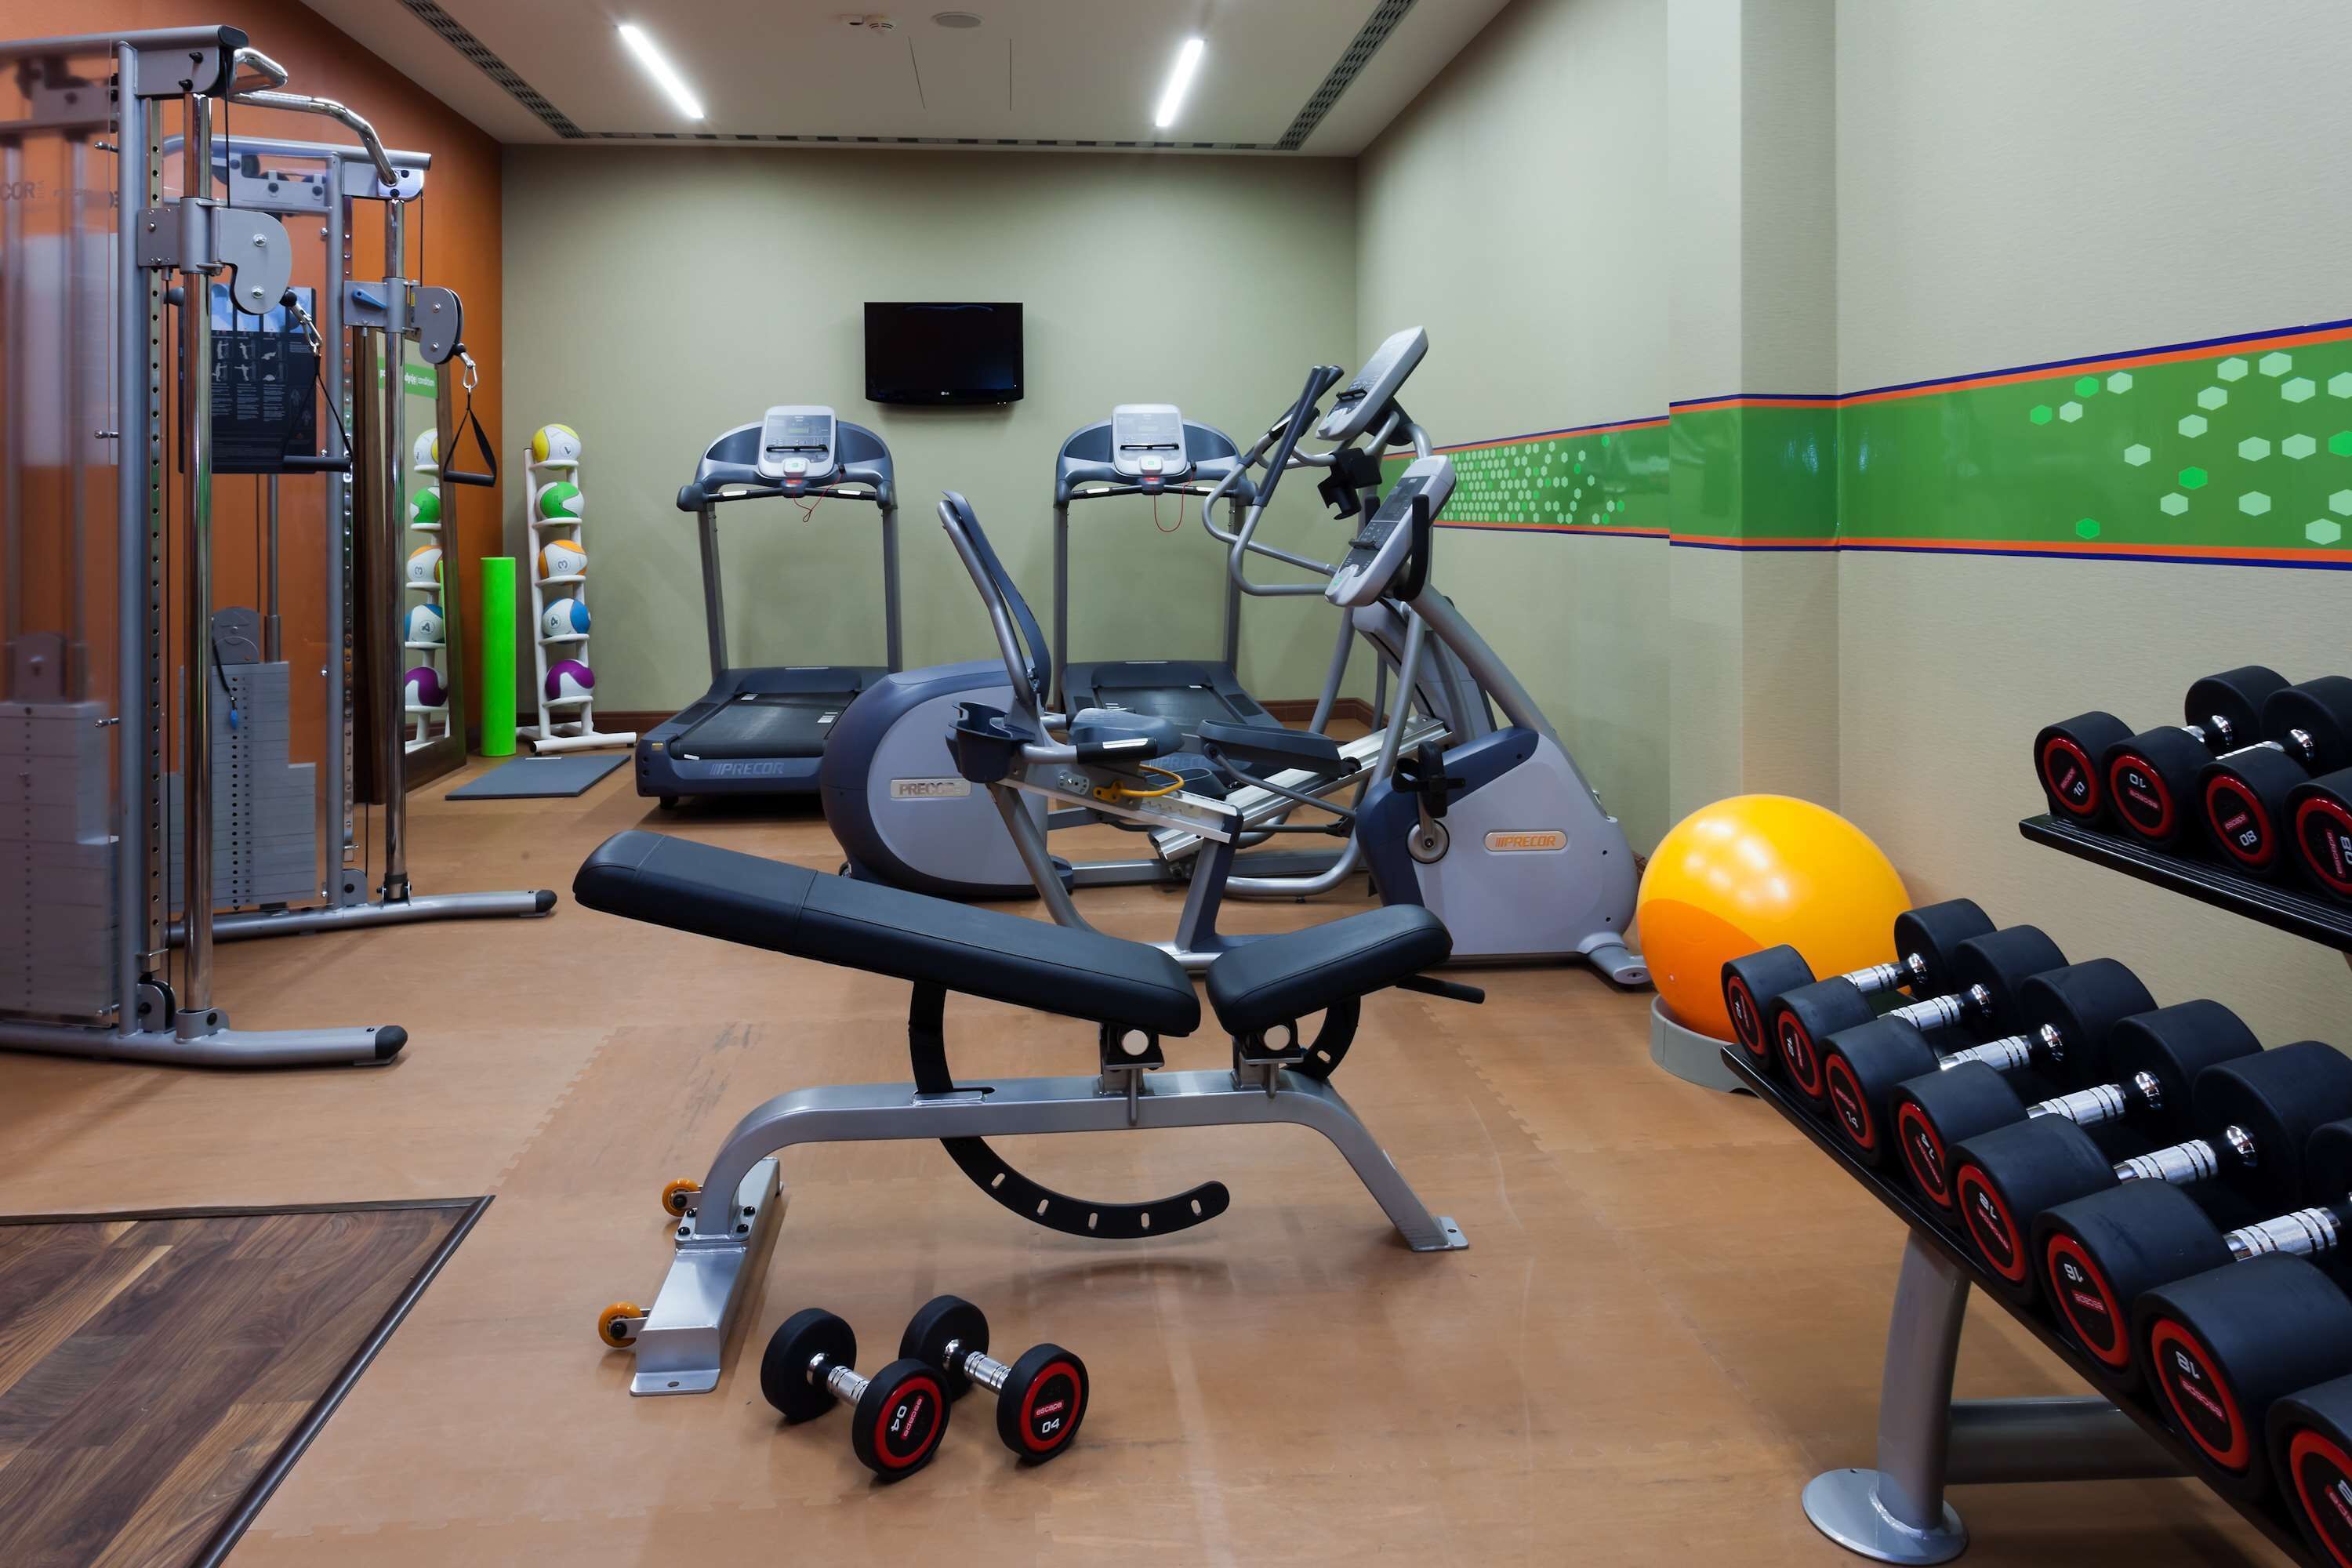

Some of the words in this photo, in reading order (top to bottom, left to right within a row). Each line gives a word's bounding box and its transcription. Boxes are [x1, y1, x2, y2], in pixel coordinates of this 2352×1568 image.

[557, 559, 568, 569] 3
[550, 616, 559, 626] 4
[720, 762, 785, 775] PRECOR
[2073, 781, 2085, 797] 10
[2129, 773, 2147, 789] 10
[1504, 835, 1556, 848] PRECOR
[2239, 829, 2258, 847] 08
[2063, 1262, 2084, 1283] 16
[2175, 1350, 2201, 1380] 18
[1036, 1401, 1063, 1416] escape
[891, 1405, 908, 1432] 04
[902, 1398, 923, 1437] escape
[1041, 1417, 1060, 1434] 04
